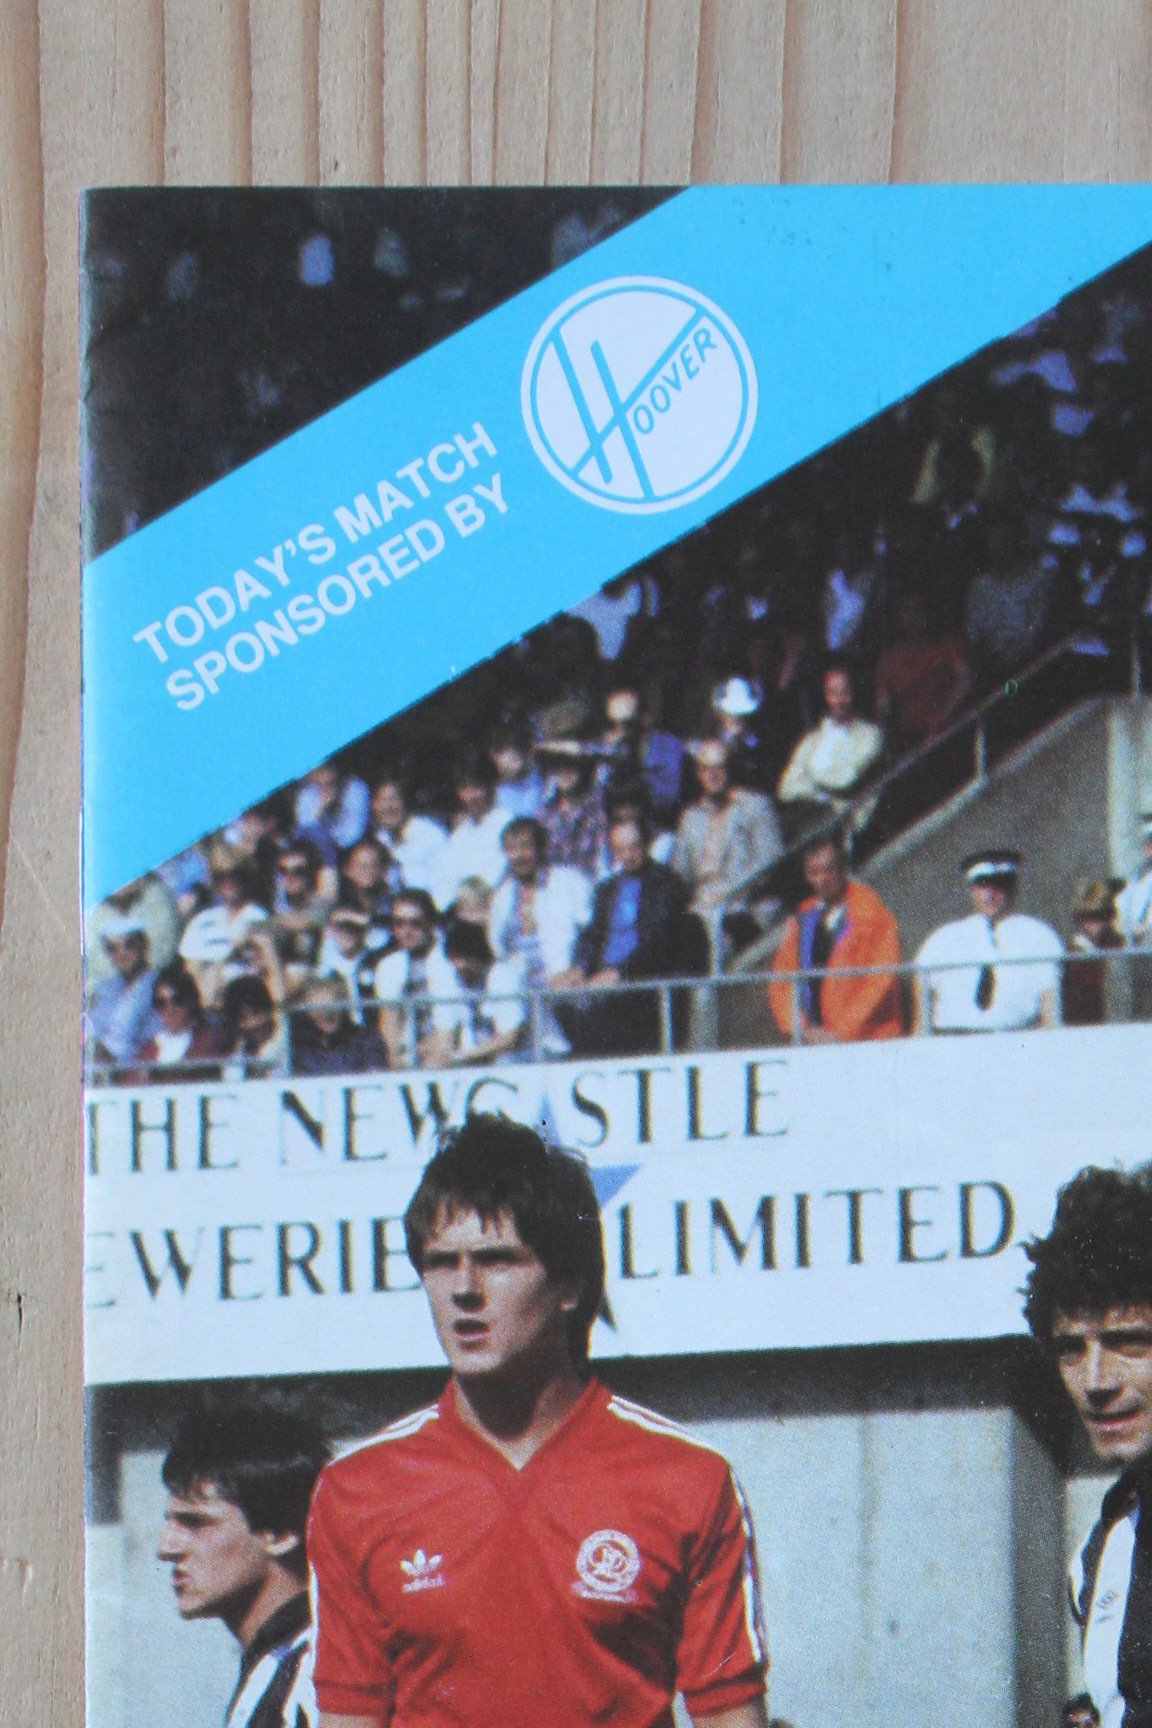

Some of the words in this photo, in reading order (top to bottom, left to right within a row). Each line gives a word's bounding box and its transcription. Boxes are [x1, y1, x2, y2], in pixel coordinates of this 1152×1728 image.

[133, 523, 336, 664] TODAY'S
[341, 421, 497, 545] MATCH
[166, 517, 446, 711] SPONSORED
[444, 474, 510, 538] BY
[84, 1094, 240, 1176] THE
[616, 1180, 1016, 1279] LIMITED
